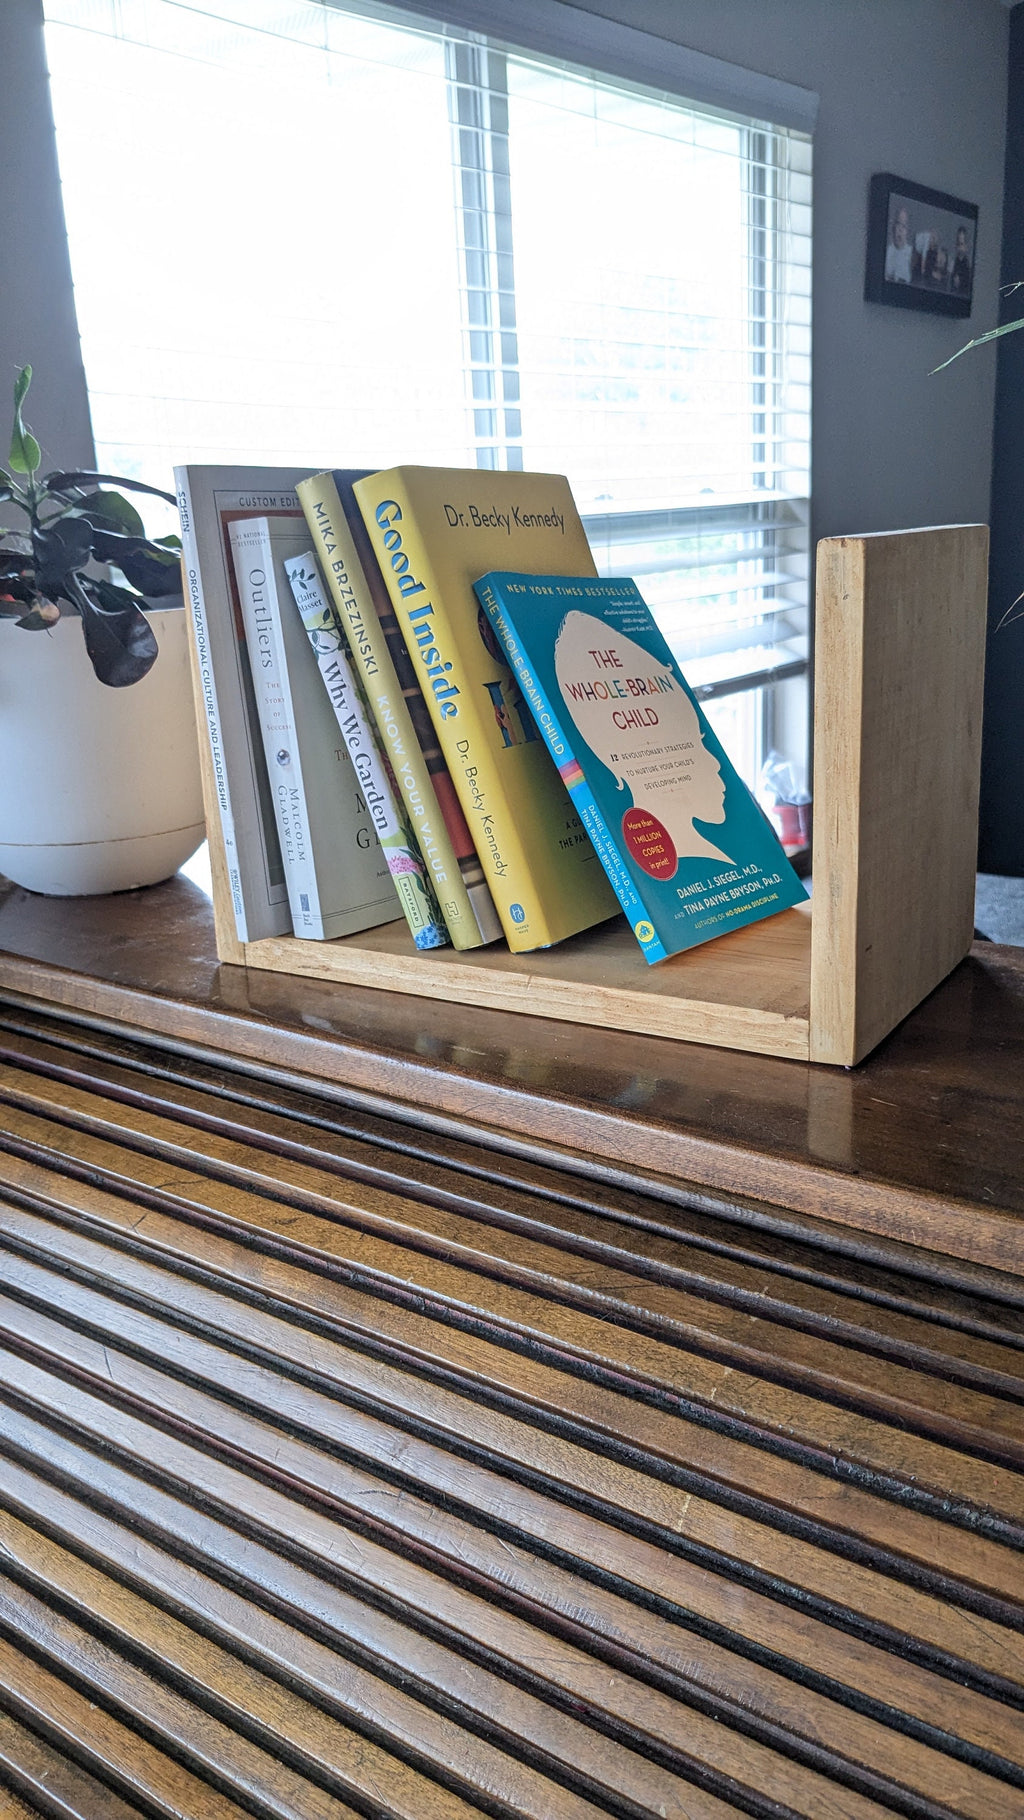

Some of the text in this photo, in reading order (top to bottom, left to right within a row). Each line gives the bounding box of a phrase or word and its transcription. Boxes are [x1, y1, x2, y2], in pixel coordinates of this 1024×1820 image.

[178, 491, 190, 533] SCHEIN
[239, 497, 277, 507] CUSTOM
[444, 504, 565, 535] Dr. Becky Kennedy
[296, 591, 318, 604] Claire
[298, 599, 323, 612] Masset
[313, 502, 379, 675] MIKA BRZEZINSKI
[506, 584, 636, 597] NEW YORK TIMES BESTSELLER
[249, 569, 273, 668] Outliers
[375, 500, 461, 720] Good Inside
[481, 586, 500, 616] THE
[495, 615, 545, 712] WHOLE-BRAIN
[540, 712, 565, 756] CHILD
[588, 650, 624, 669] THE
[189, 569, 228, 811] ORGANIZATIONAL CULTURE AND LEADERSHIP
[565, 675, 674, 702] WHOLE-BRAIN
[612, 707, 659, 731] CHILD
[324, 661, 348, 710] Why
[342, 712, 361, 749] We
[355, 753, 388, 830] Garden
[610, 742, 695, 762] 12 REVOLUTIONARY STRATEGIES
[626, 758, 695, 777] TO NURTURE YOUR CHILD'S
[644, 774, 692, 791] DEVELOPING MIND
[377, 695, 448, 884] KNOW YOUR VALUE
[278, 785, 295, 865] GLADWELL
[289, 788, 306, 861] MALCOLM
[456, 739, 508, 878] Dr. Becky Kennedy
[627, 819, 654, 831] More than
[558, 837, 574, 849] THE
[581, 808, 592, 829] TINA
[590, 828, 605, 856] PAYNE
[637, 831, 662, 843] MILLION
[588, 804, 605, 834] DANIEL
[605, 841, 621, 872] SIEGEL,
[628, 892, 638, 905] AND
[642, 846, 665, 858] COPIES
[649, 857, 670, 870] in print!
[676, 863, 763, 899] DANIEL J. SIEGEL, M.D.,
[403, 882, 419, 922] BATSFORD
[673, 912, 685, 920] AND
[683, 901, 705, 916] TINA
[703, 891, 731, 909] PAYNE
[728, 880, 765, 900] BRYSON,
[694, 892, 780, 929] AUTHORS OF NO-DRAMA DISCIPLINE
